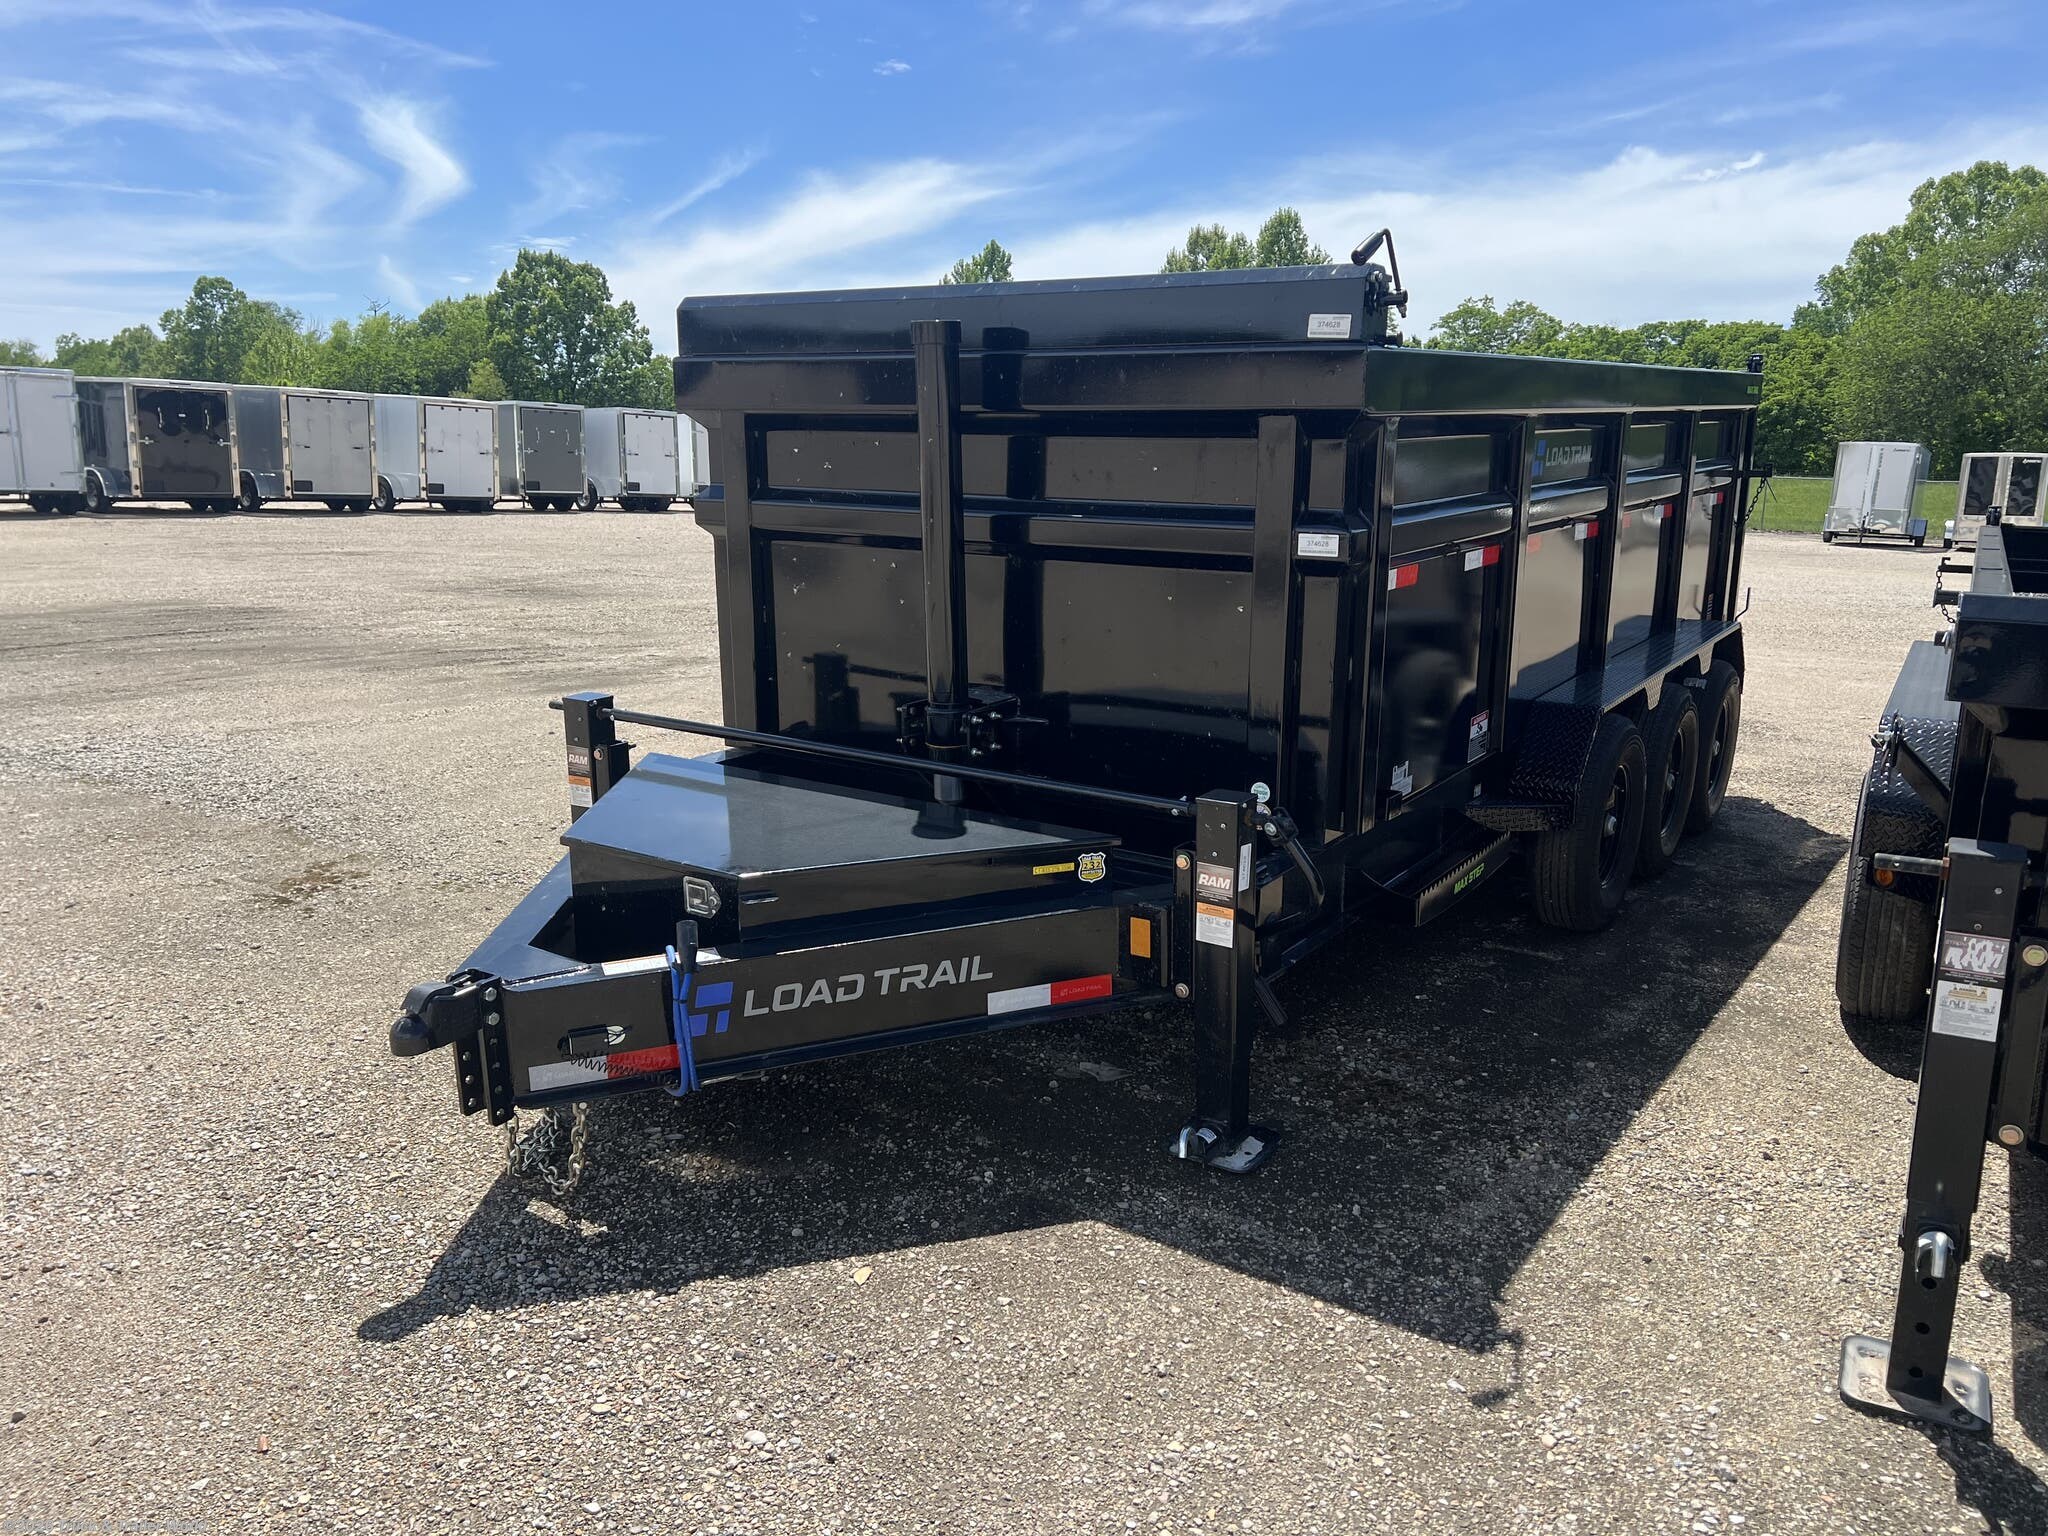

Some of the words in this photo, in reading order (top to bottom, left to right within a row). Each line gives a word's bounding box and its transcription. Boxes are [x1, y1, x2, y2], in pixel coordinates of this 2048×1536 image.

[1317, 320, 1341, 329] 374628
[1545, 448, 1570, 466] LOAD
[1306, 540, 1329, 548] 374628
[568, 753, 588, 766] RAM
[1198, 873, 1231, 891] RAM
[1453, 874, 1468, 895] MAX
[1468, 862, 1485, 883] STEP
[743, 973, 866, 1017] LOAD
[873, 955, 994, 996] TRAIL
